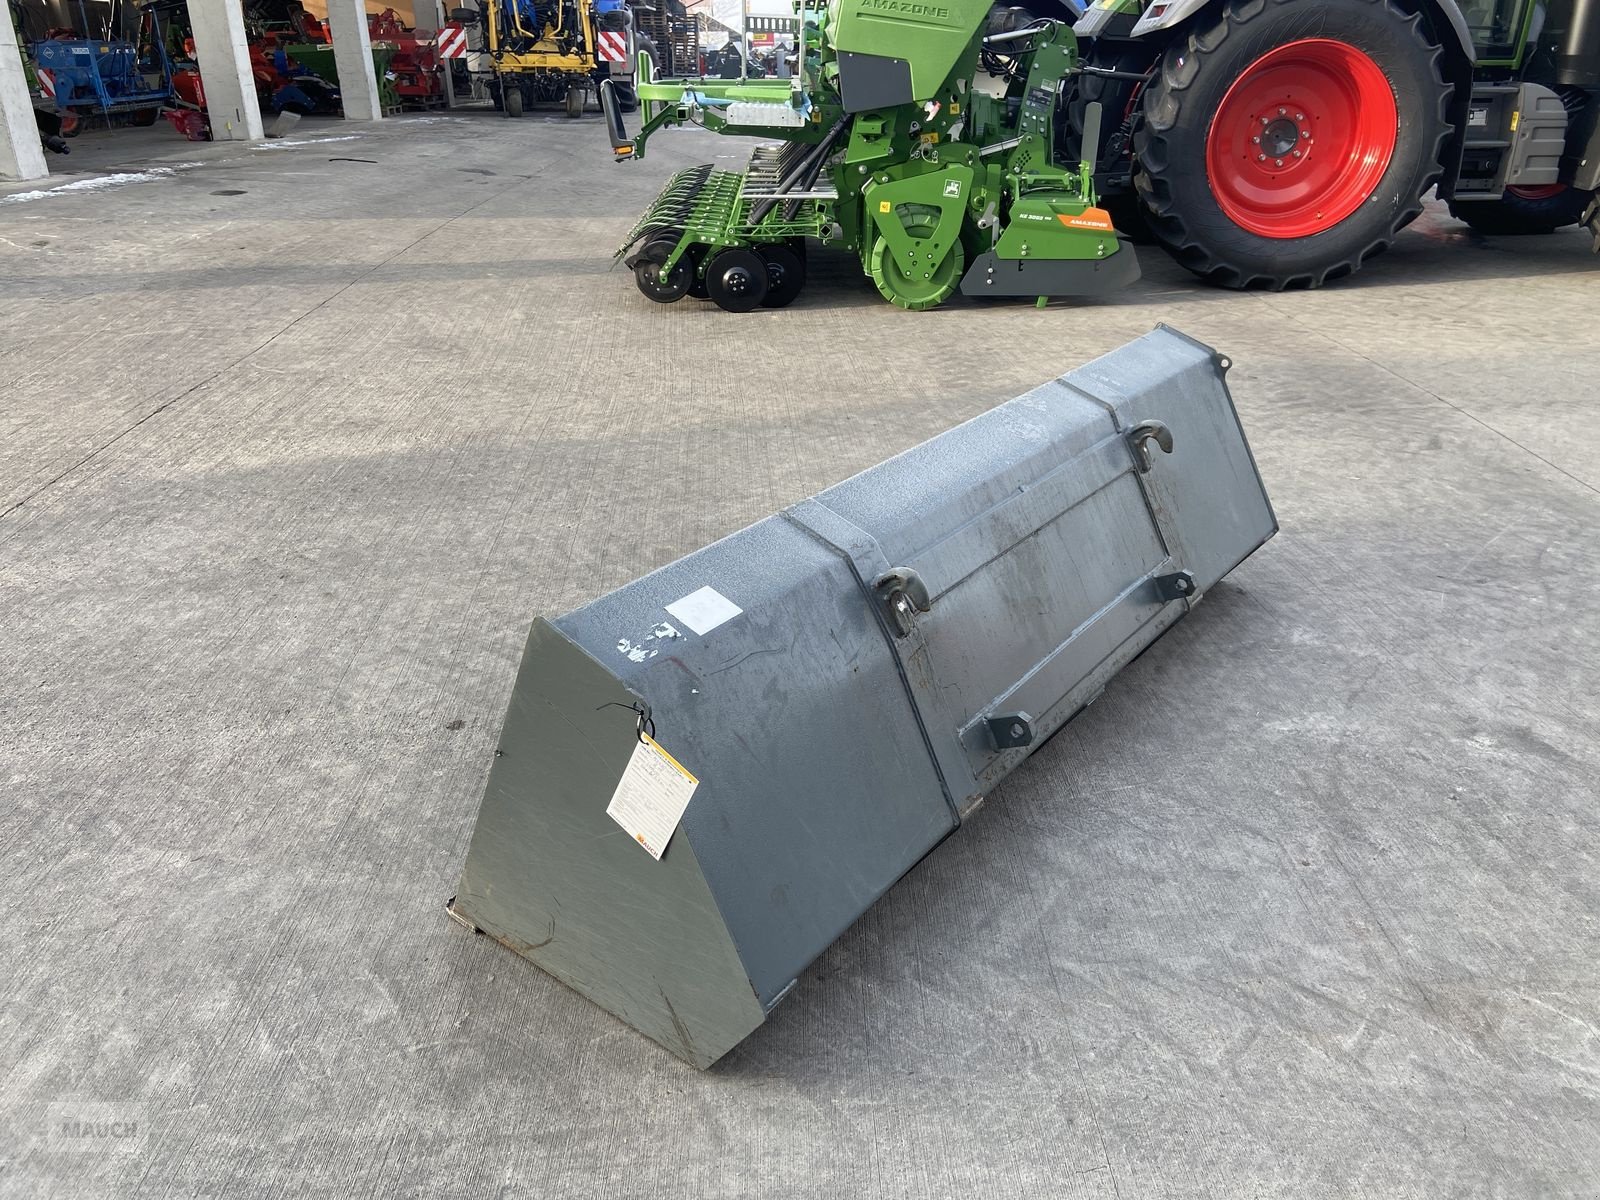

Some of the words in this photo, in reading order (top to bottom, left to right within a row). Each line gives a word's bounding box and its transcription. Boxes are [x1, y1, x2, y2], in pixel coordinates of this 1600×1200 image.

[861, 0, 948, 17] AMAZONE
[1070, 219, 1108, 228] AMAZONE
[637, 836, 658, 857] MAUCH
